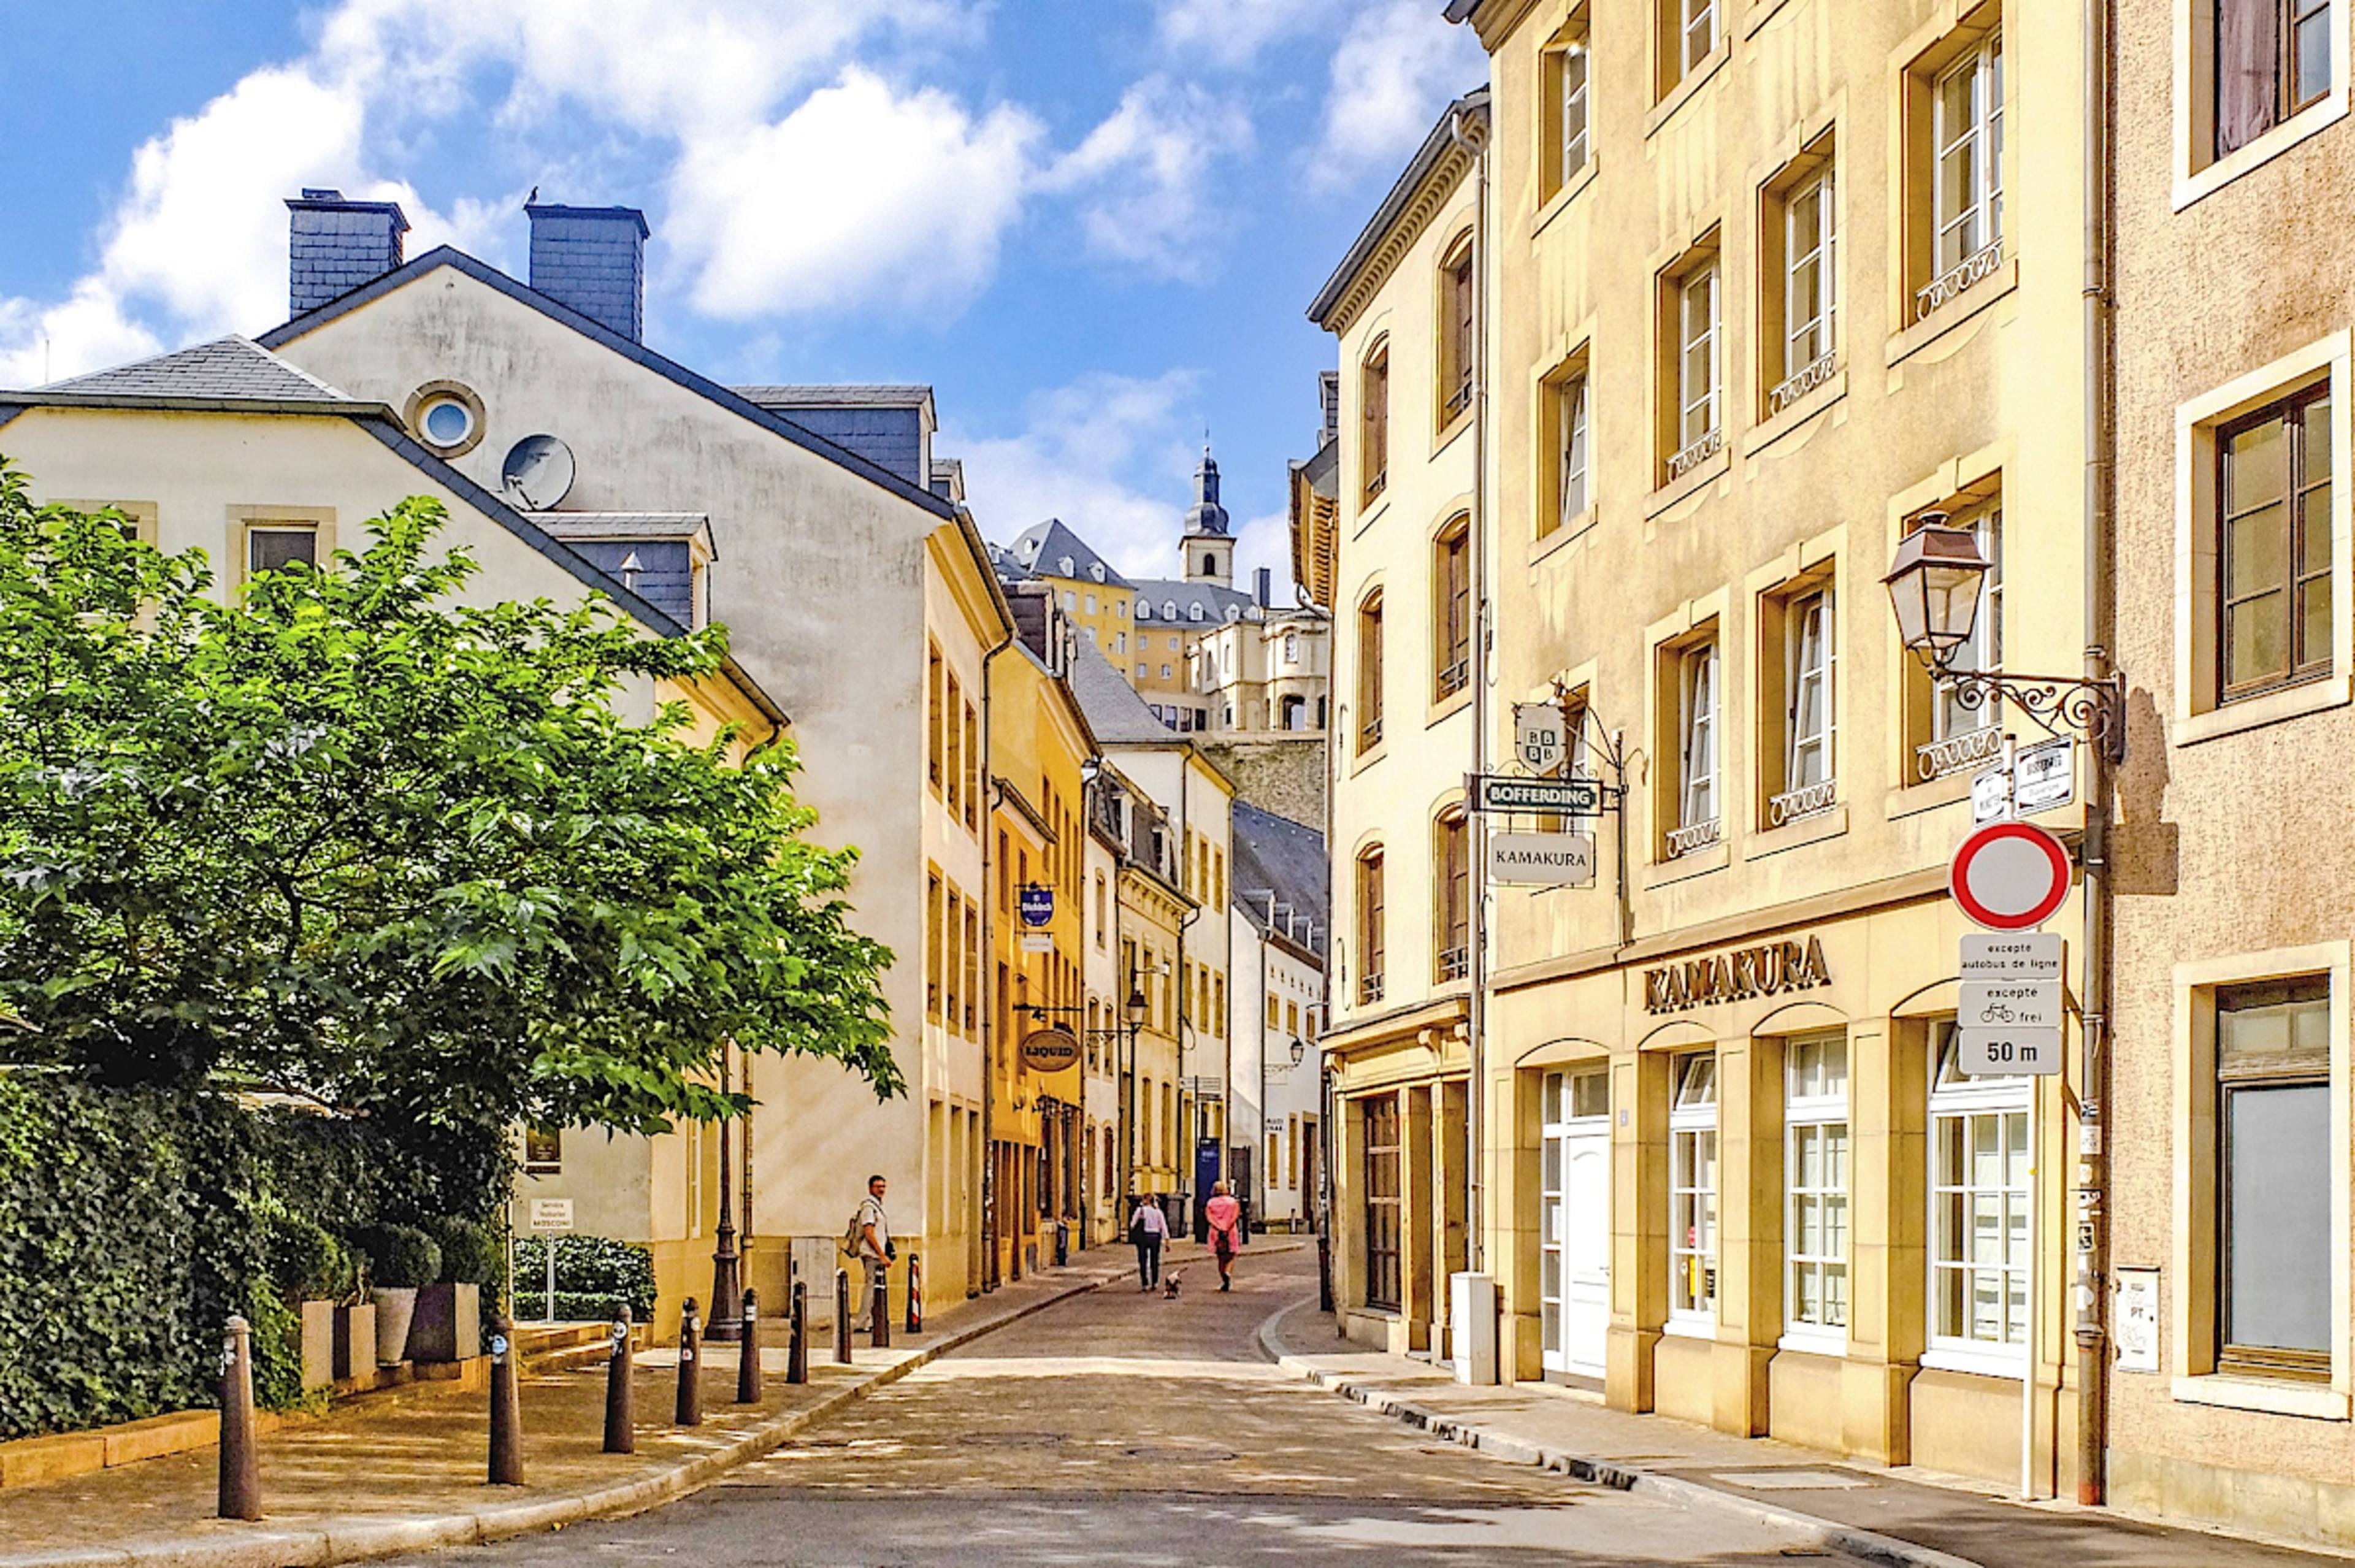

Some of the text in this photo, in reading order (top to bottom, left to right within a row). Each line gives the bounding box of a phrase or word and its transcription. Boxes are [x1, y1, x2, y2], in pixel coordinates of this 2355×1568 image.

[1490, 786, 1590, 805] BOFFERDING
[1496, 851, 1587, 866] KAMAKURA
[2031, 959, 2058, 969] ligne
[1644, 934, 1832, 1015] KAMAKURA
[2020, 1011, 2042, 1022] frei
[1026, 1047, 1073, 1058] LIQUID
[1987, 1042, 2037, 1062] 50 m
[2131, 1307, 2143, 1318] PT
